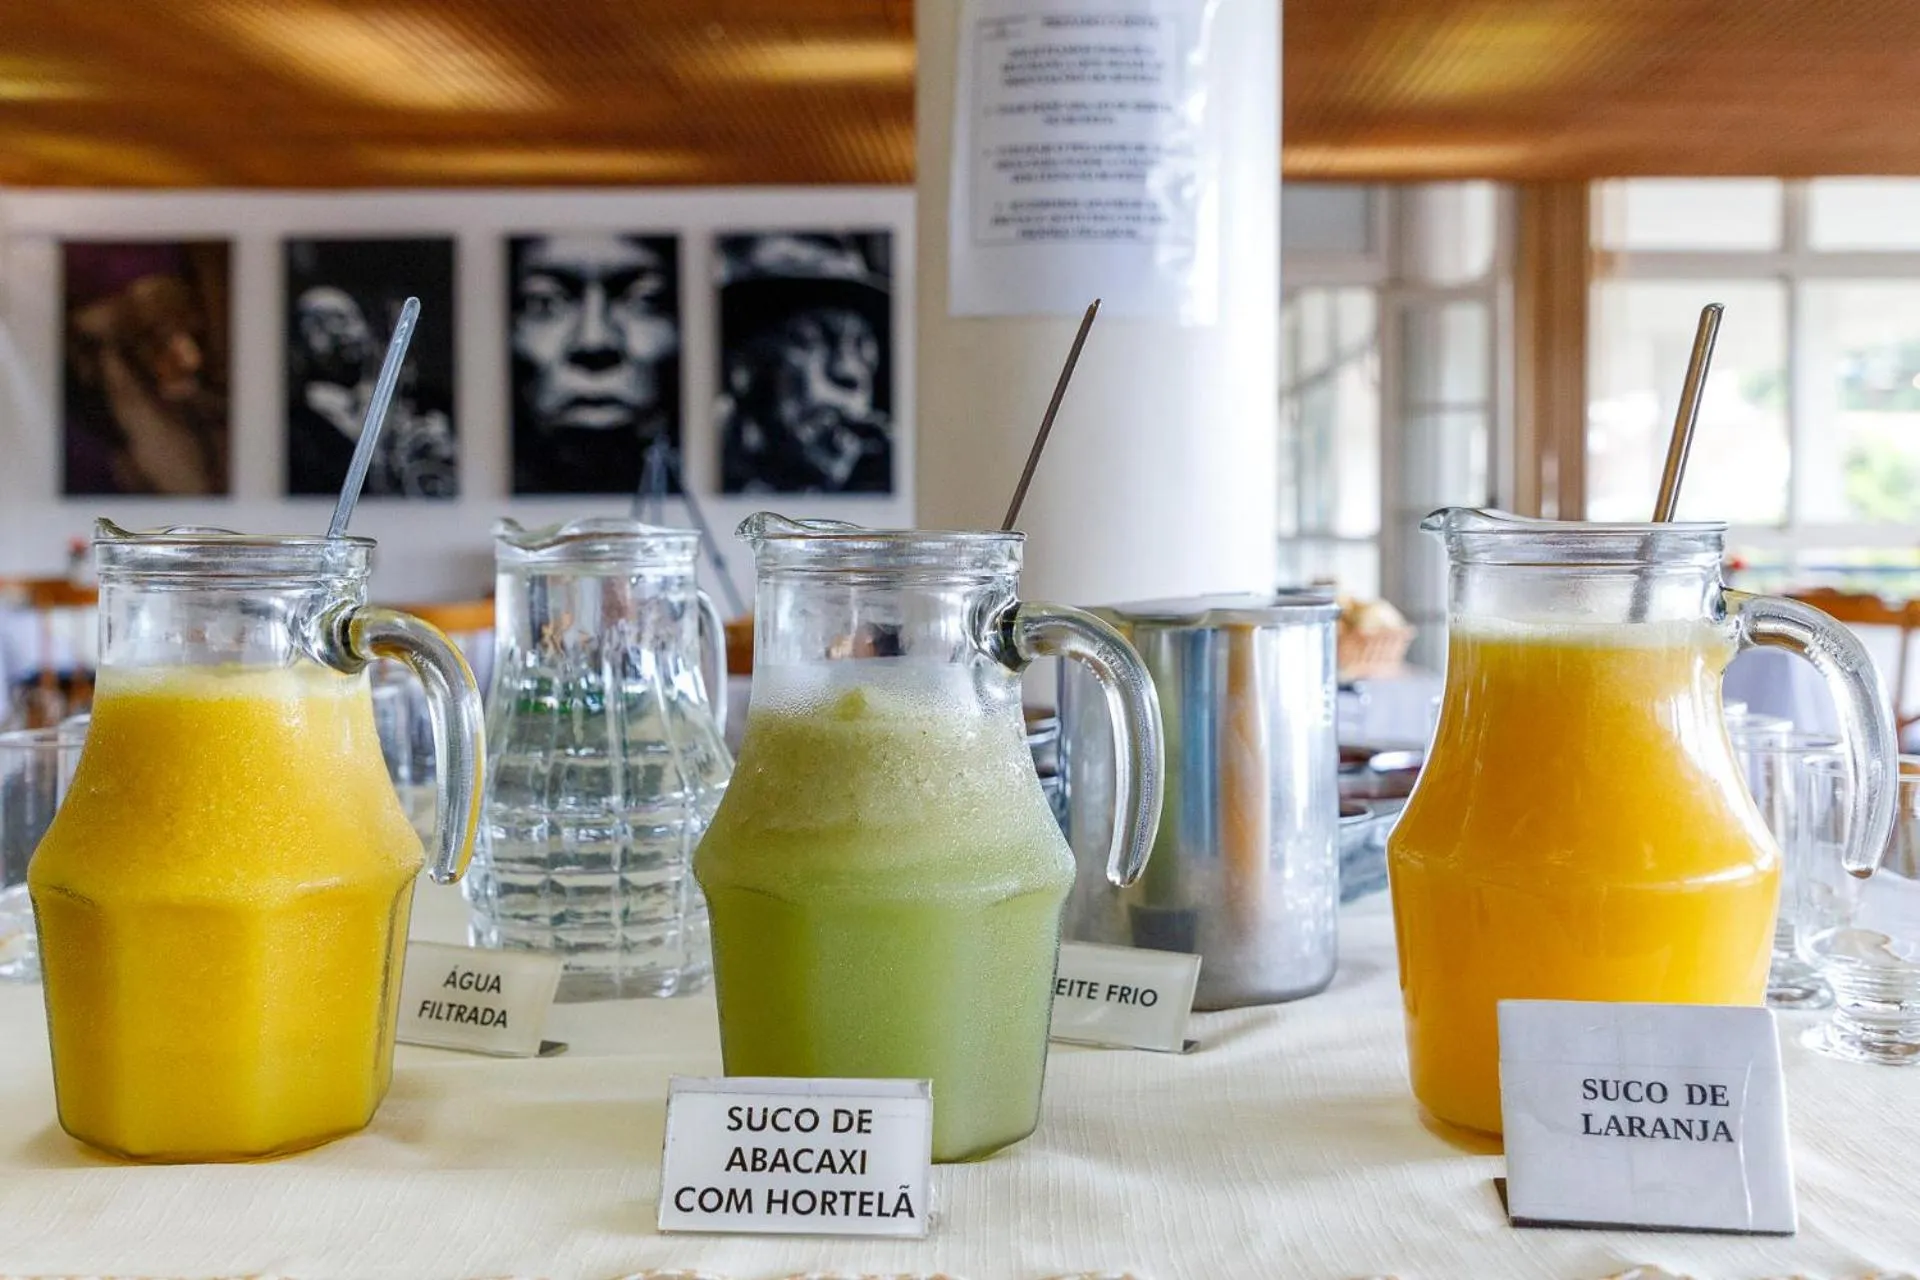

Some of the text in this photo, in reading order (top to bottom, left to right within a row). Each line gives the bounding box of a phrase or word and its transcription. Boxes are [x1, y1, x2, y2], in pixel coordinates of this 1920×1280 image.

[443, 965, 501, 994] ÁGUA
[1055, 978, 1158, 1007] EITE FRIO
[418, 1000, 508, 1028] FILTRADA
[1582, 1078, 1730, 1107] SUCO DE
[727, 1106, 873, 1134] SUCO DE
[1582, 1112, 1735, 1143] LARANJA
[725, 1146, 867, 1175] ABACAXI
[674, 1184, 915, 1218] COM HORTELÃ
